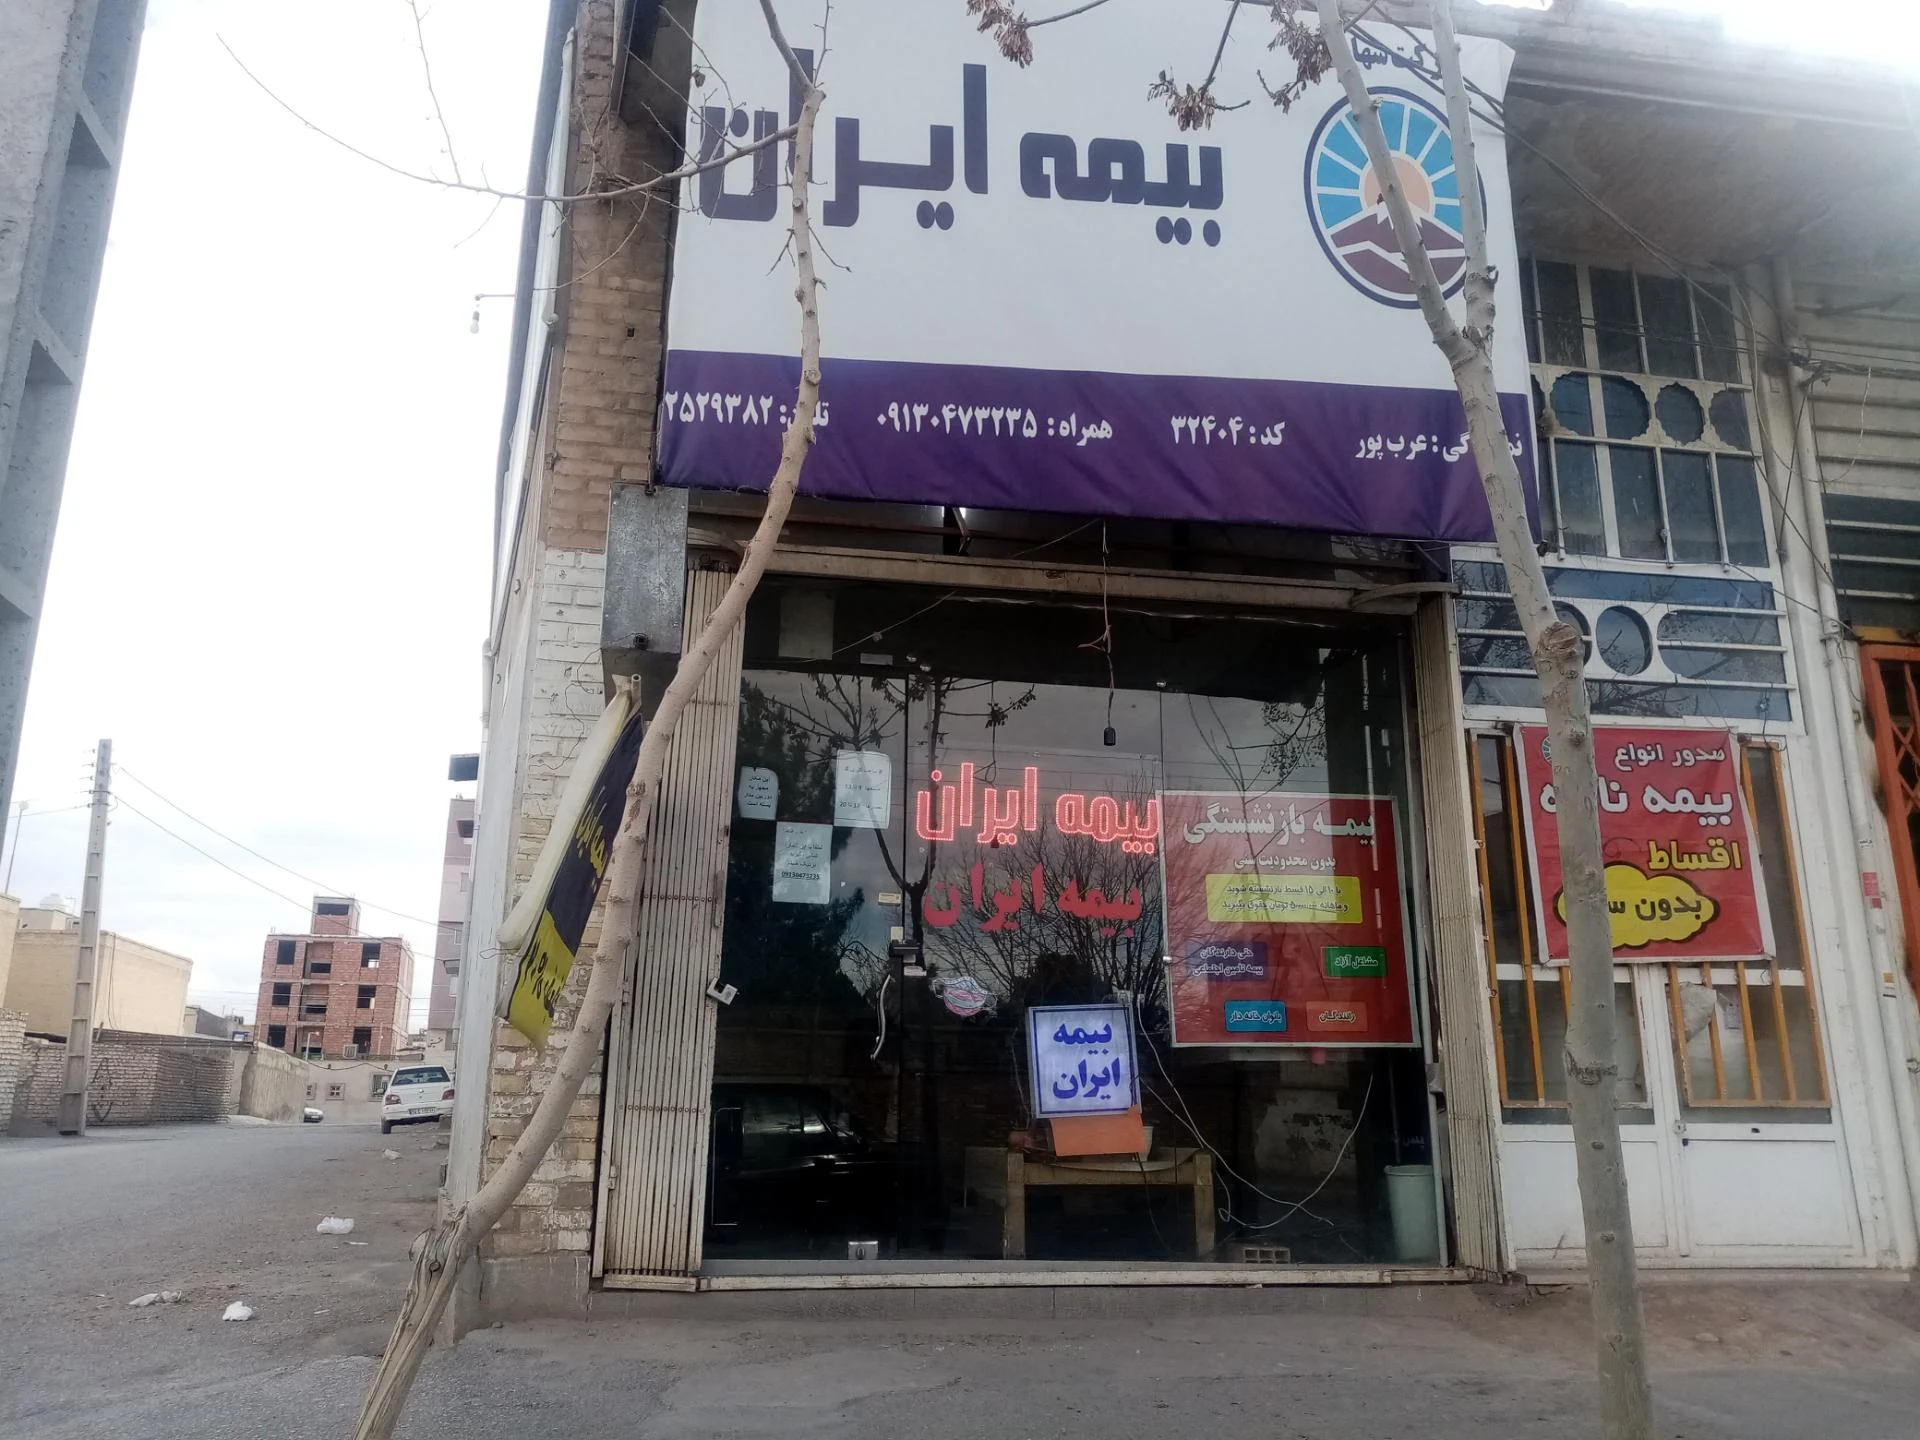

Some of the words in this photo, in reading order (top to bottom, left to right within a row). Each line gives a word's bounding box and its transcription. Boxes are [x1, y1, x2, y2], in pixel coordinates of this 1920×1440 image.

[699, 48, 989, 231] ایران
[1020, 132, 1224, 247] بیمه
[876, 400, 1037, 438] ۰۹۱۳۰۴۷۳۲۳۵
[1171, 415, 1243, 446] ۳۲۴۰۴
[1354, 434, 1384, 460] پور
[1386, 435, 1427, 460] عرب
[1614, 743, 1663, 772] انواع
[1671, 747, 1726, 767] صدور
[916, 762, 1038, 845] ایران
[1540, 776, 1630, 814] ناه
[1642, 783, 1734, 826] بیمه
[1055, 793, 1160, 855] بیمه
[1184, 801, 1305, 846] بازنشستگی
[1312, 809, 1376, 846] بیمه
[1234, 855, 1257, 870] سنی
[1258, 855, 1308, 870] محدودیت
[1310, 855, 1336, 870] بدون
[1648, 837, 1742, 872] اقساط
[924, 863, 1045, 933] ایران
[1284, 884, 1303, 896] قسط
[1635, 893, 1702, 921] بدون
[1057, 879, 1144, 938] بیمه
[1053, 1022, 1113, 1055] بیمه
[1052, 1056, 1121, 1100] ایران
